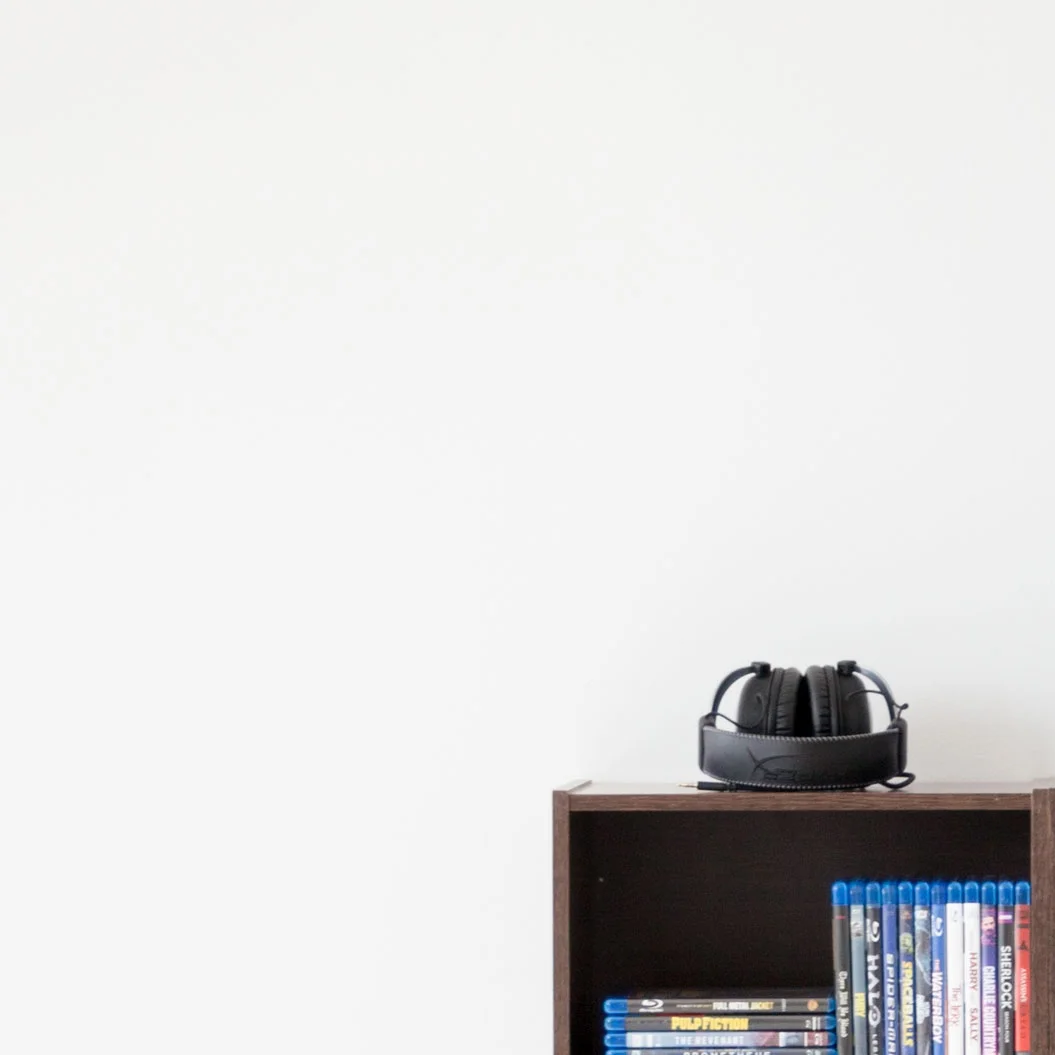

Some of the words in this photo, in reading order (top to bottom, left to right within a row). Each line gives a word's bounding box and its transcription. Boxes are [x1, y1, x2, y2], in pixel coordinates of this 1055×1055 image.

[969, 952, 978, 991] HARRY
[983, 965, 996, 1004] CHARLIE
[1000, 945, 1013, 1010] SHERLOCK
[866, 954, 881, 1027] HALO
[902, 961, 914, 1047] SPACEBALLS
[671, 1016, 701, 1030] PULP
[702, 1016, 748, 1030] FICTION
[838, 1018, 850, 1038] Blood
[969, 1007, 979, 1042] SALLY
[1003, 1011, 1011, 1029] SEASON
[674, 1036, 693, 1045] THE
[695, 1036, 744, 1045] REVENANT
